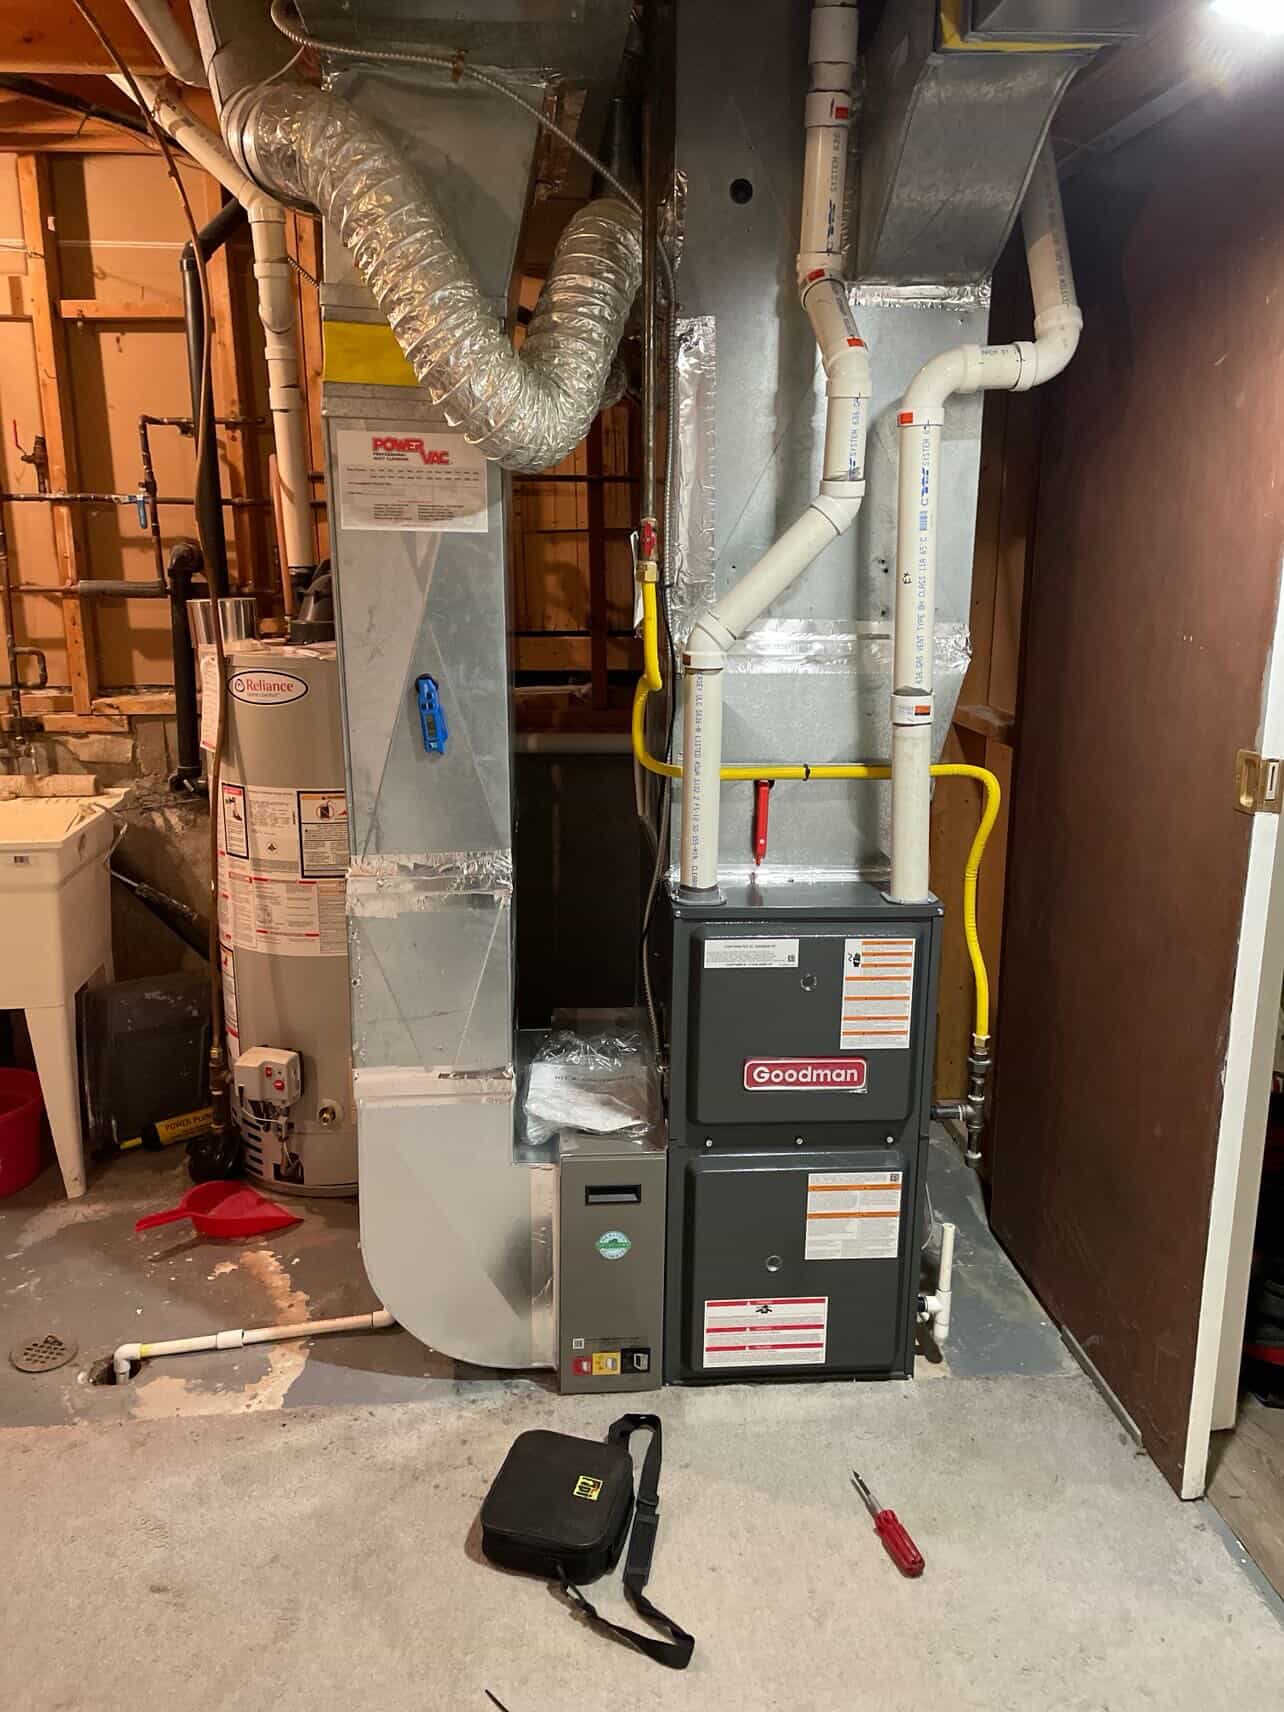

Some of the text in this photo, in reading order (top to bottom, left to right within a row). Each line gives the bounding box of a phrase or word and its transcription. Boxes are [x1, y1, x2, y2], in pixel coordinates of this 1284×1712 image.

[372, 437, 425, 453] POWER
[420, 448, 450, 464] VAC
[915, 613, 925, 630] TYPE
[246, 679, 295, 692] Reliance
[752, 1066, 858, 1083] Goodman
